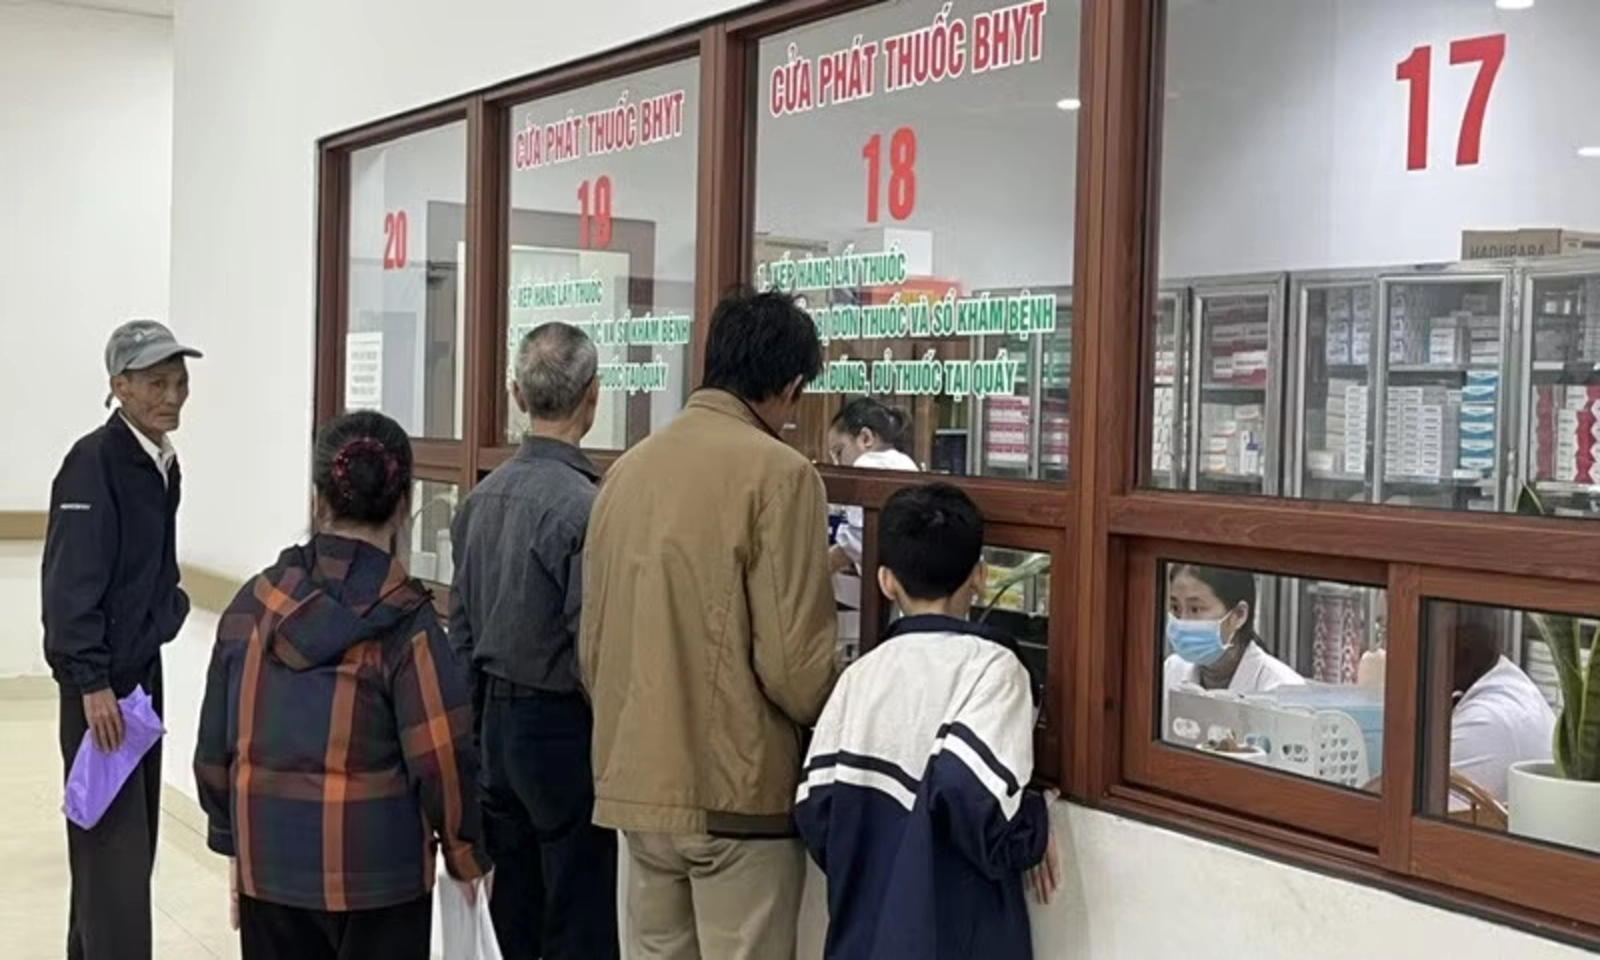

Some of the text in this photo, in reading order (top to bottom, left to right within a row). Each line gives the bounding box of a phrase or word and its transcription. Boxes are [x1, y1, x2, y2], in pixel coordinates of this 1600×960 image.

[770, 0, 1047, 117] CỬA PHÁT THUỐC BHYT
[586, 90, 637, 156] THUỐC
[640, 89, 685, 145] BHYT
[1396, 33, 1506, 171] 17
[862, 126, 917, 223] 18
[383, 210, 408, 270] 20
[577, 174, 613, 250] 19
[796, 253, 833, 291] HÀNG
[833, 243, 859, 289] LẤY
[861, 240, 909, 287] THUỐC
[861, 292, 908, 339] THUỐC
[908, 294, 931, 338] VÀ
[932, 287, 956, 336] SỔ
[956, 291, 1005, 336] KHÁM
[1007, 289, 1057, 340] BỆNH
[829, 354, 871, 397] ĐÚNG,
[872, 347, 893, 395] ĐỦ
[894, 349, 942, 395] THUỐC
[944, 360, 971, 401] TẠI
